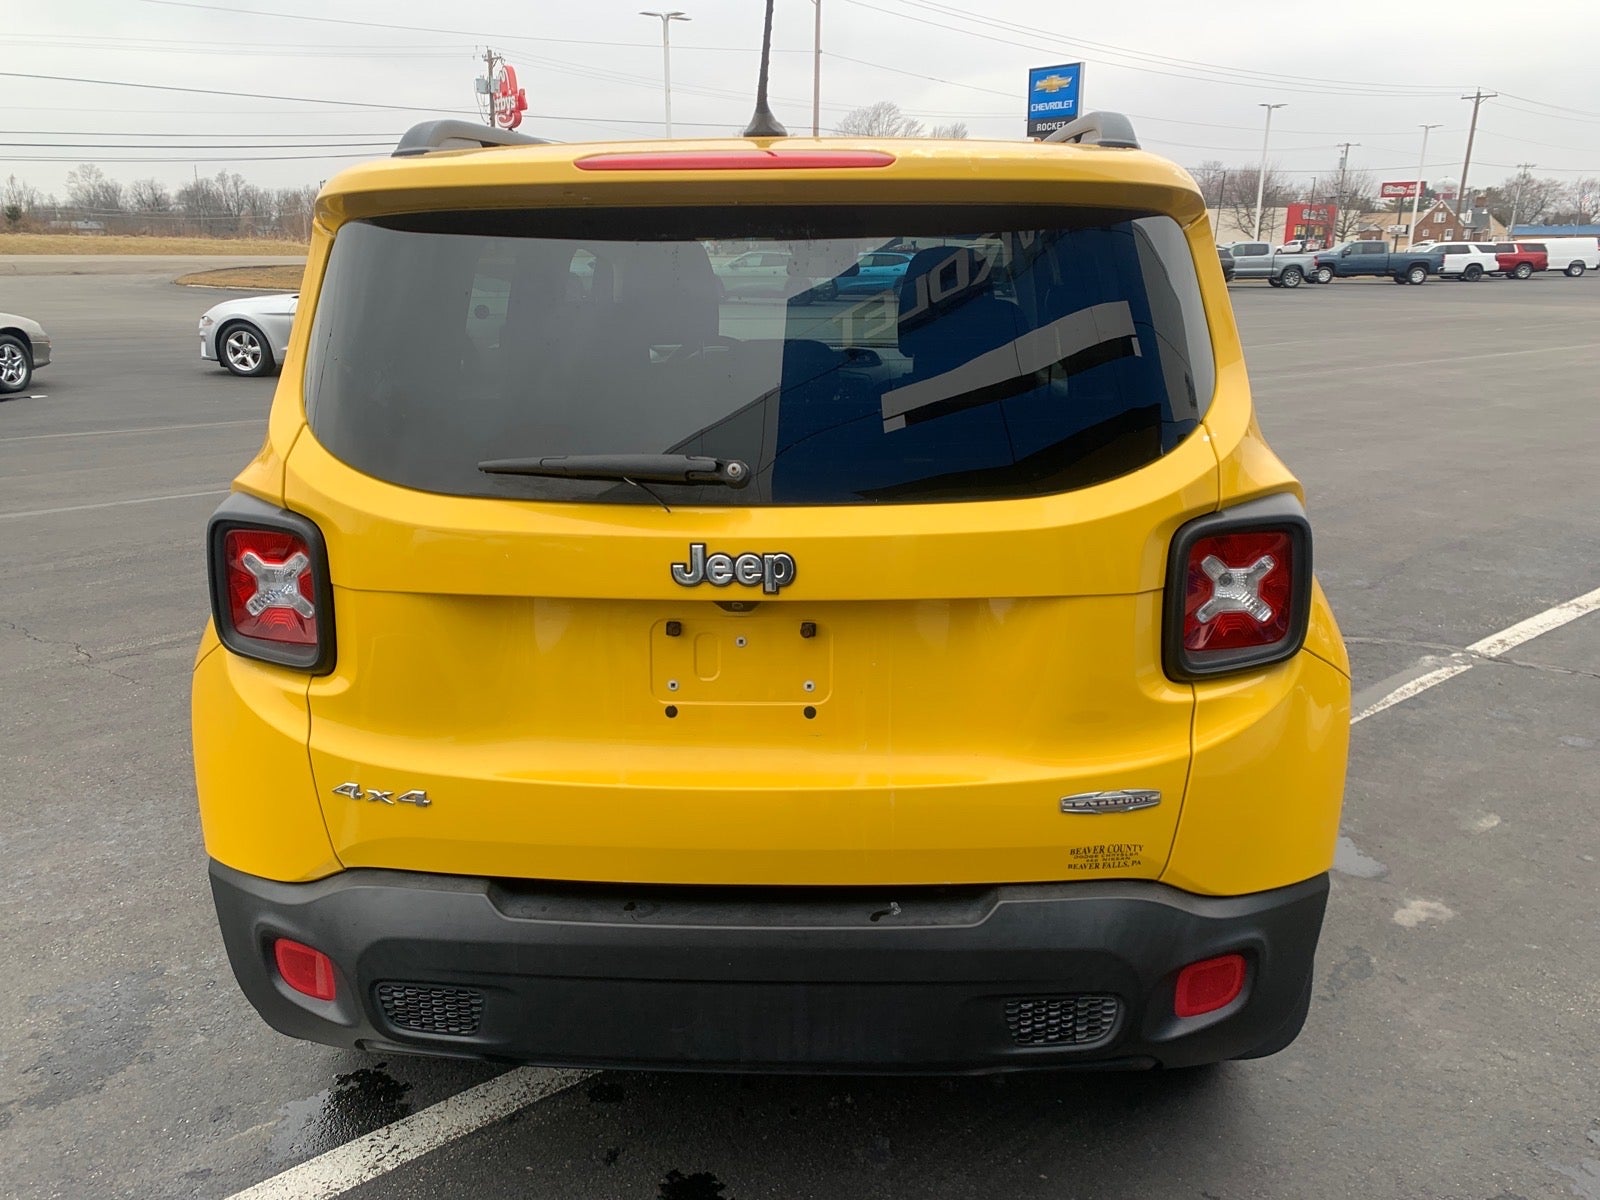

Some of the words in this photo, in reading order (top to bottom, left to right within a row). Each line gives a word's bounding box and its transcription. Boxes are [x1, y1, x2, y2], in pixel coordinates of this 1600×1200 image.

[1031, 99, 1074, 112] CHEVROLET
[671, 542, 796, 594] Jeep
[332, 782, 432, 807] 4x4
[1070, 846, 1105, 856] BEAVER
[1107, 844, 1144, 853] COUNTY
[1067, 862, 1100, 870] BEAVER
